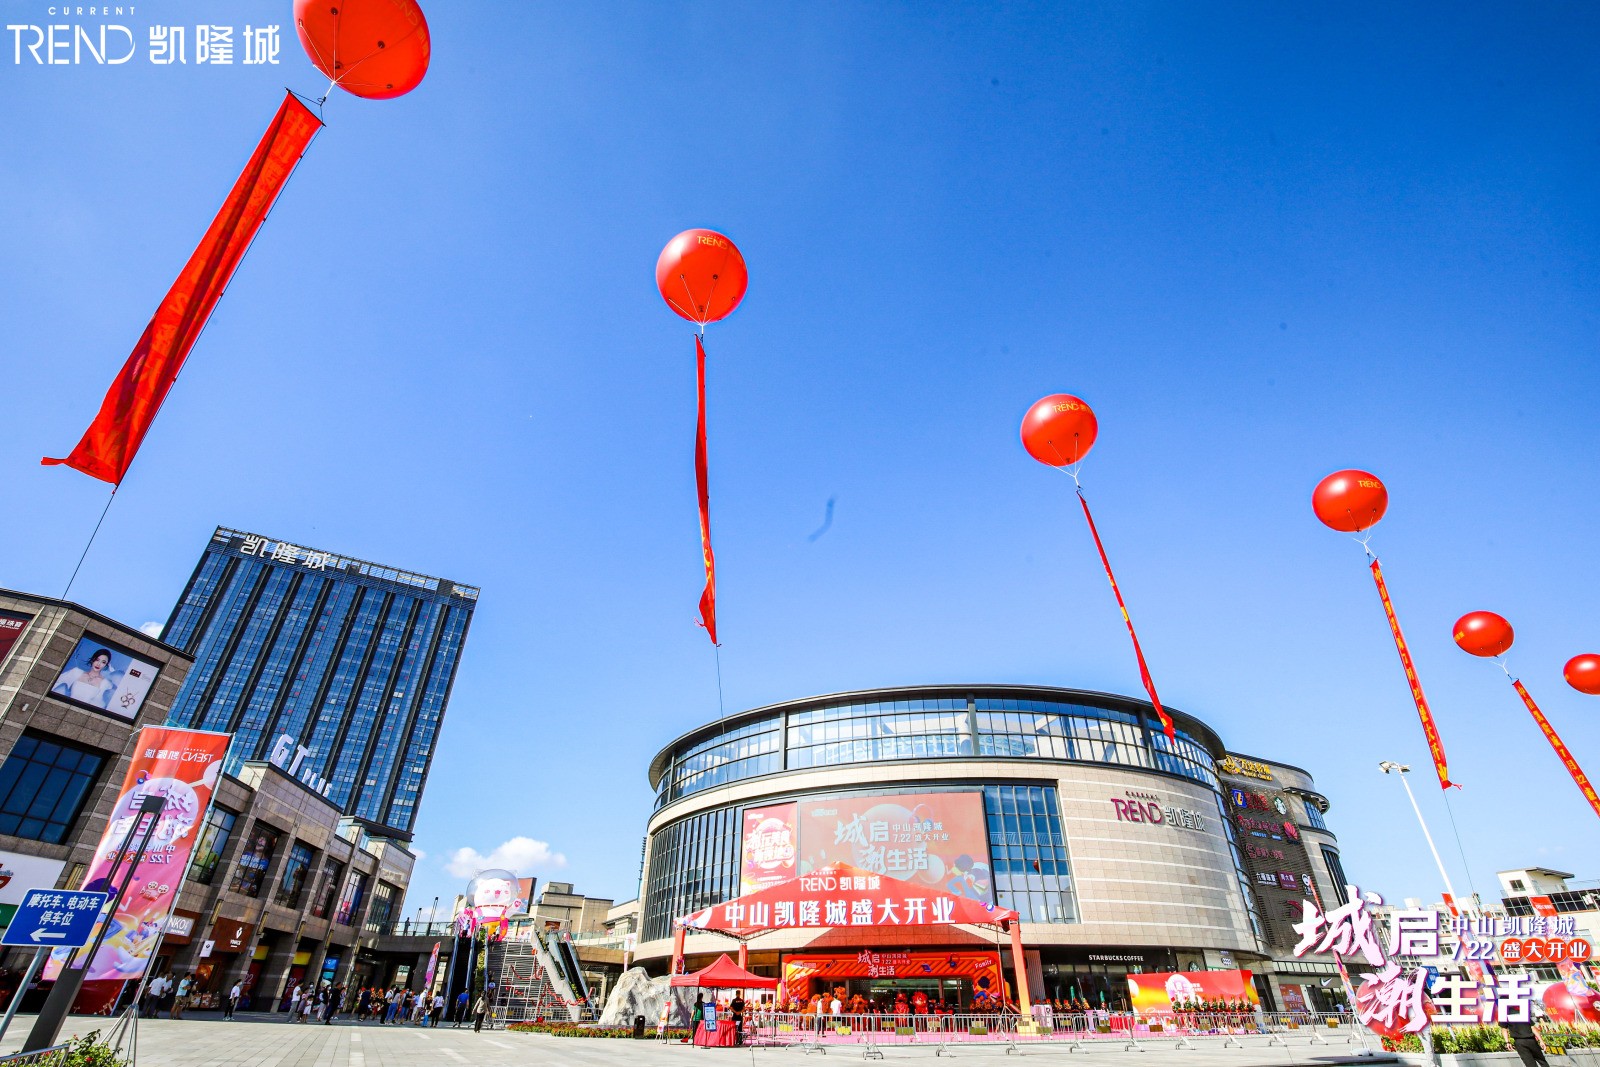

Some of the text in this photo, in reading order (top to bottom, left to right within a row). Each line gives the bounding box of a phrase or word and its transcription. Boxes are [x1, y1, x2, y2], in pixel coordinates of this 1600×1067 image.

[1053, 403, 1079, 413] TREND
[240, 534, 331, 571] 凯隆城
[270, 734, 333, 798] GT PLUS
[1110, 798, 1163, 824] TREND
[834, 813, 889, 847] 城启
[892, 821, 943, 833] 中山凯隆城
[893, 833, 950, 843] 7.22 盛大开业
[860, 845, 929, 874] 潮生活
[799, 877, 837, 892] TREND
[839, 876, 881, 891] 凯隆城
[27, 893, 100, 911] 摩托车、电动车
[38, 911, 74, 926] 停车位
[725, 897, 956, 928] 中山凯隆城盛大开业
[857, 949, 880, 965] 城启
[975, 959, 992, 969] Family
